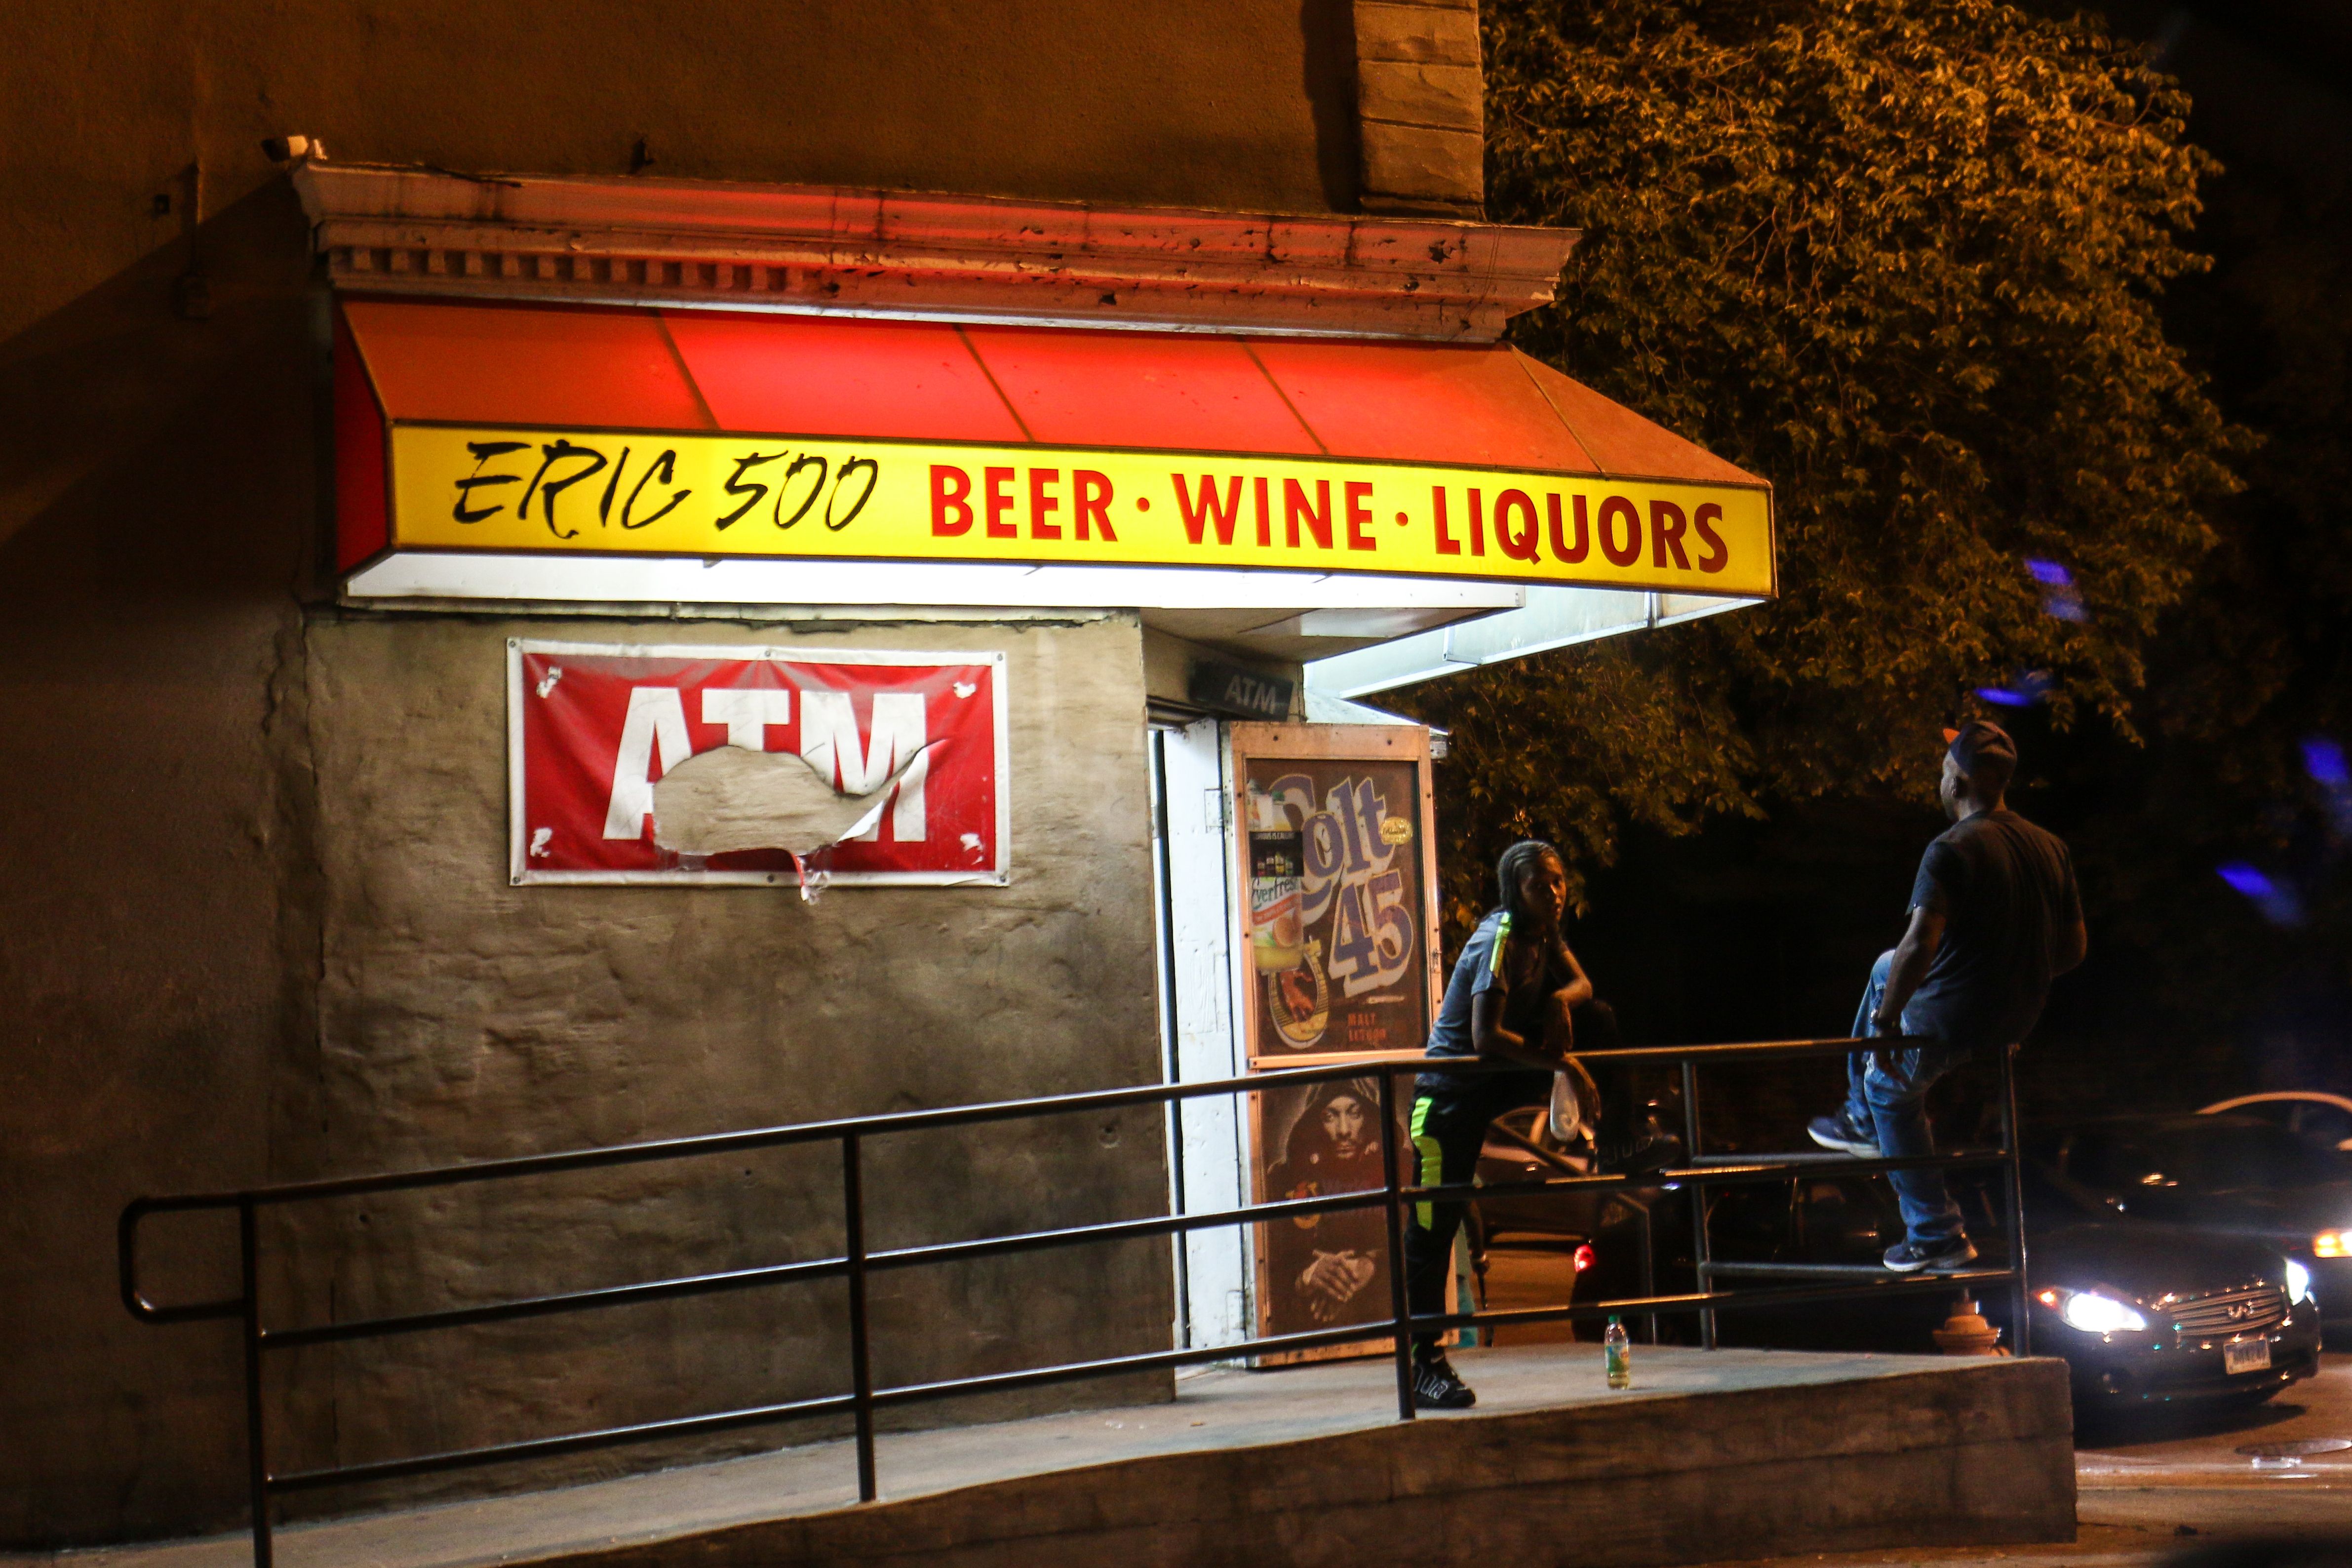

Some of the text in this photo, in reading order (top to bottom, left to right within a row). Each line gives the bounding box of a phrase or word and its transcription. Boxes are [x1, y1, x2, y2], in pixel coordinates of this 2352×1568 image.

[452, 439, 1728, 573] ERIC 500 BEER WINE LIQUORS
[1225, 673, 1277, 715] ATM
[602, 686, 926, 842] ATM
[1328, 869, 1413, 998] 45
